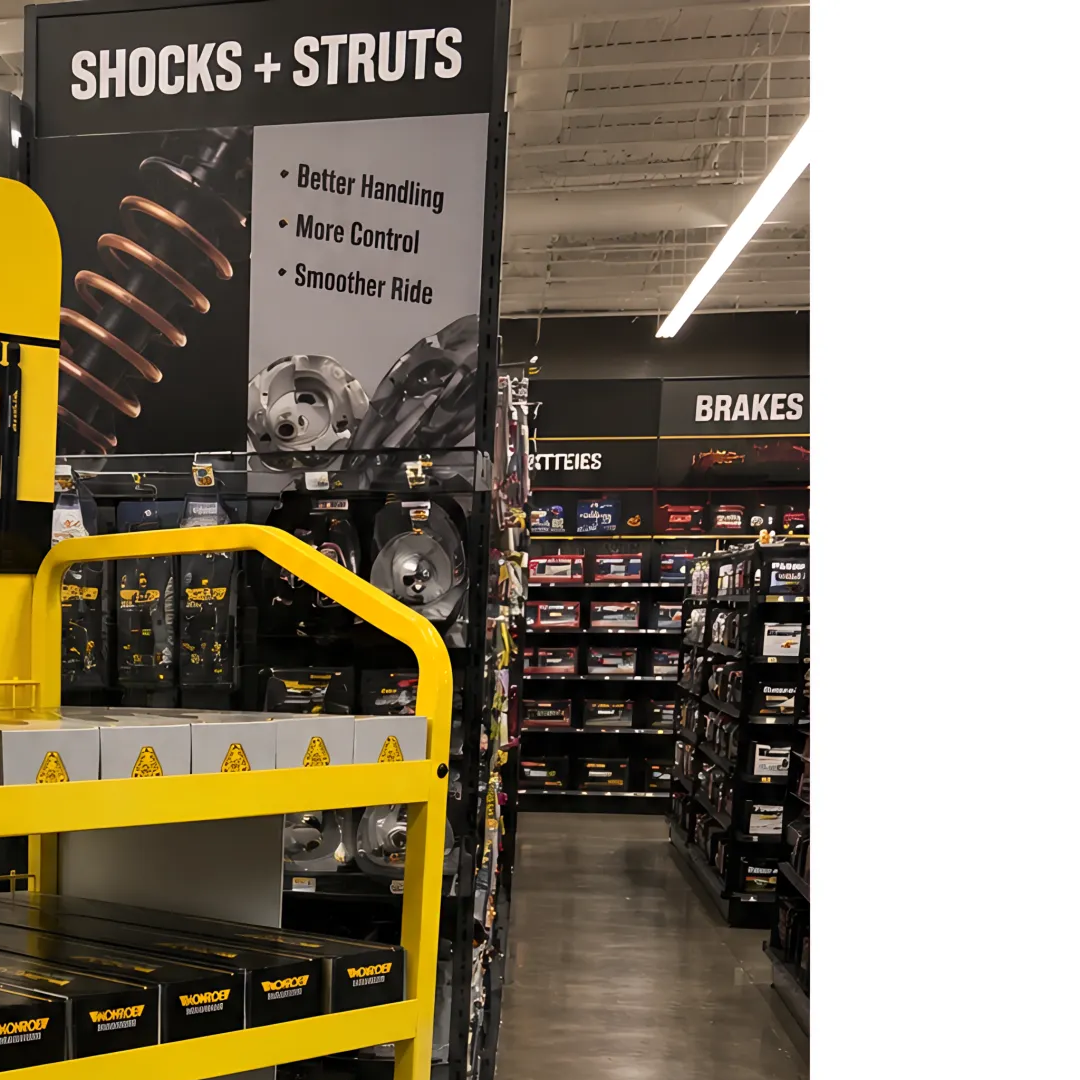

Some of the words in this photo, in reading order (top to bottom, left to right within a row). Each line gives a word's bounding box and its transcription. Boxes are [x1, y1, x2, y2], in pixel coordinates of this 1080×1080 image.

[70, 40, 242, 100] SHOCKS
[254, 52, 281, 84] +
[292, 27, 463, 88] STRUTS
[297, 163, 356, 196] Better
[360, 173, 445, 214] Handling
[295, 214, 345, 244] More
[350, 221, 420, 255] Control
[295, 262, 386, 298] Smoother
[391, 274, 433, 305] Ride
[695, 393, 804, 422] BRAKES
